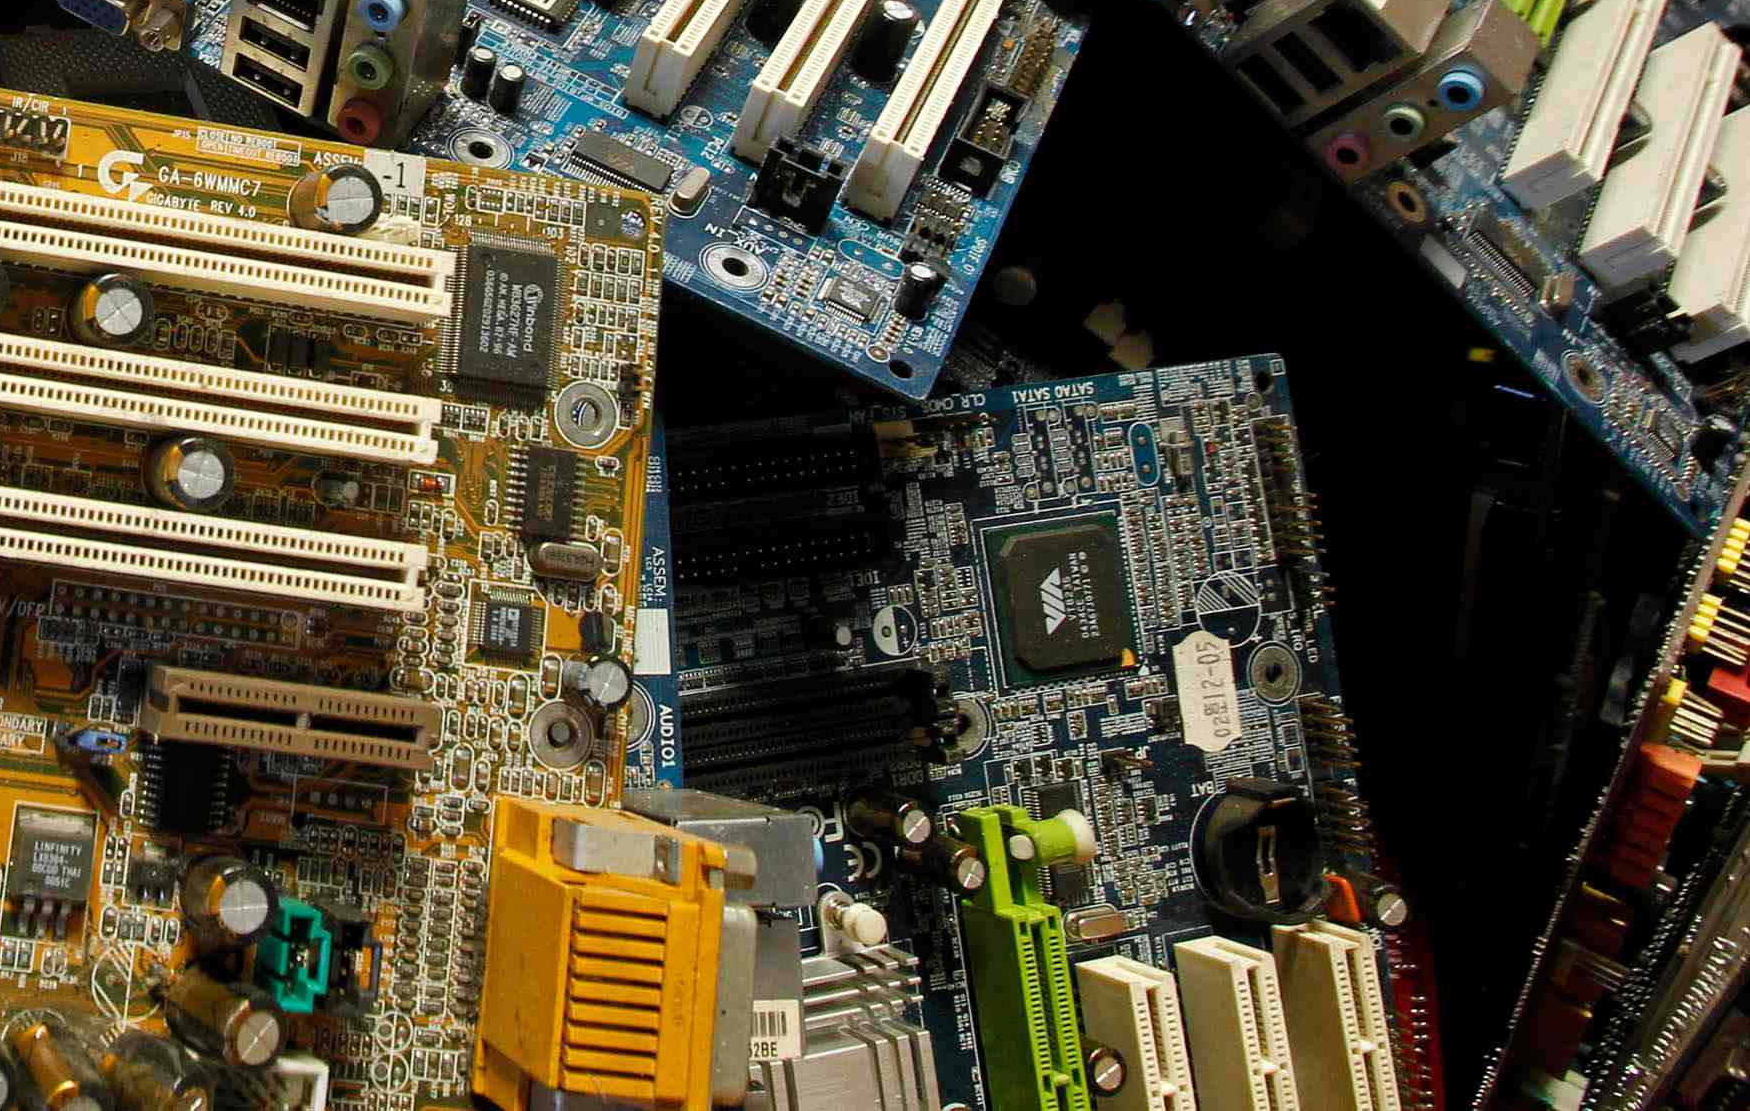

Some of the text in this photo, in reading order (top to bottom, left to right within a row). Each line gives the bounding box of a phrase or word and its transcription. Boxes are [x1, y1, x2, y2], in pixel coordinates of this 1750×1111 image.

[156, 165, 263, 199] GA-6WMMC7
[144, 190, 258, 219] GIGABYTE REV 4.0
[647, 196, 663, 253] REV 4.0
[522, 283, 544, 352] Winbond
[1010, 380, 1094, 403] SATA0 SATA1
[651, 545, 665, 603] ASSEM:
[658, 703, 676, 768] AUDIO1
[1189, 779, 1216, 798] BAT
[748, 1040, 778, 1058] 2BE
